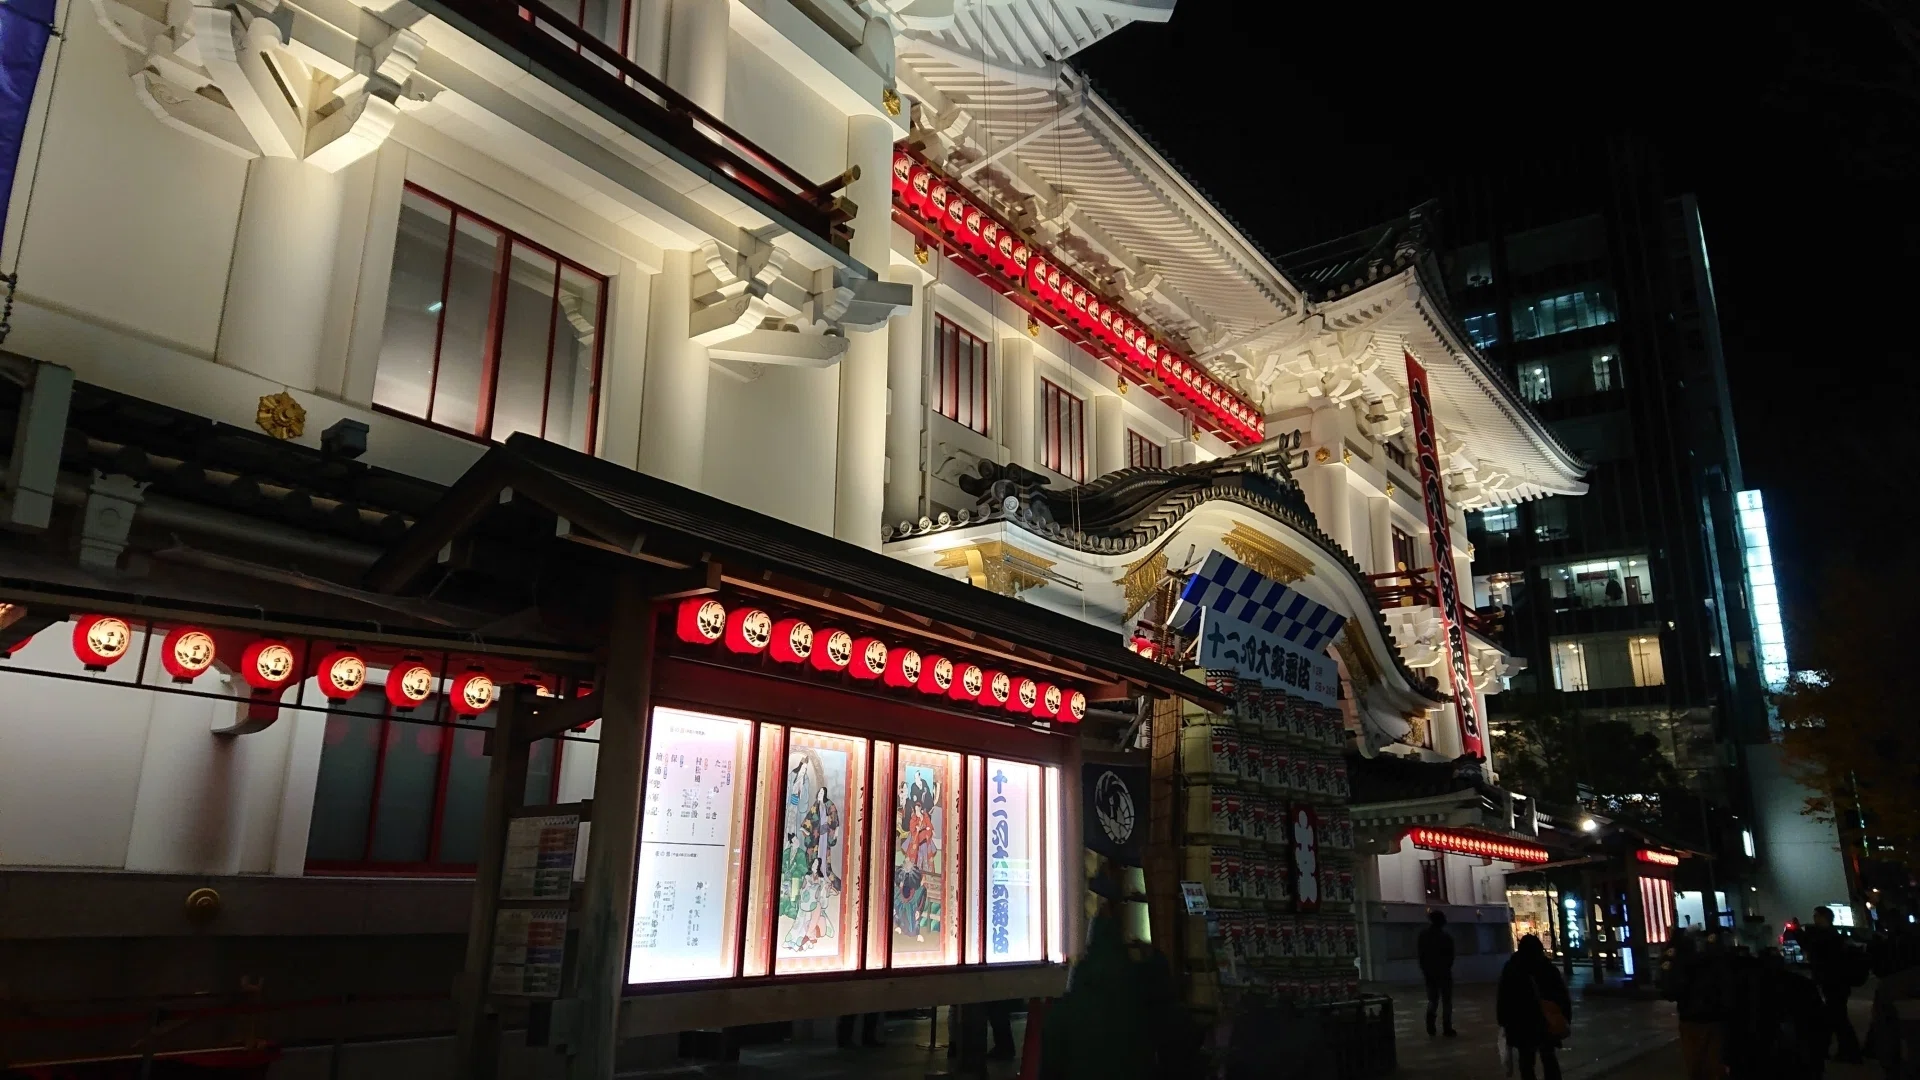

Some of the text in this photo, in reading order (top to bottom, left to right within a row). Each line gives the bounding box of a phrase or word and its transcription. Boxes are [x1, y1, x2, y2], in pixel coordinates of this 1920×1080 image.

[1206, 621, 1312, 692] 十二月大歌舞伎
[1411, 377, 1480, 740] 十二月大歌舞伎
